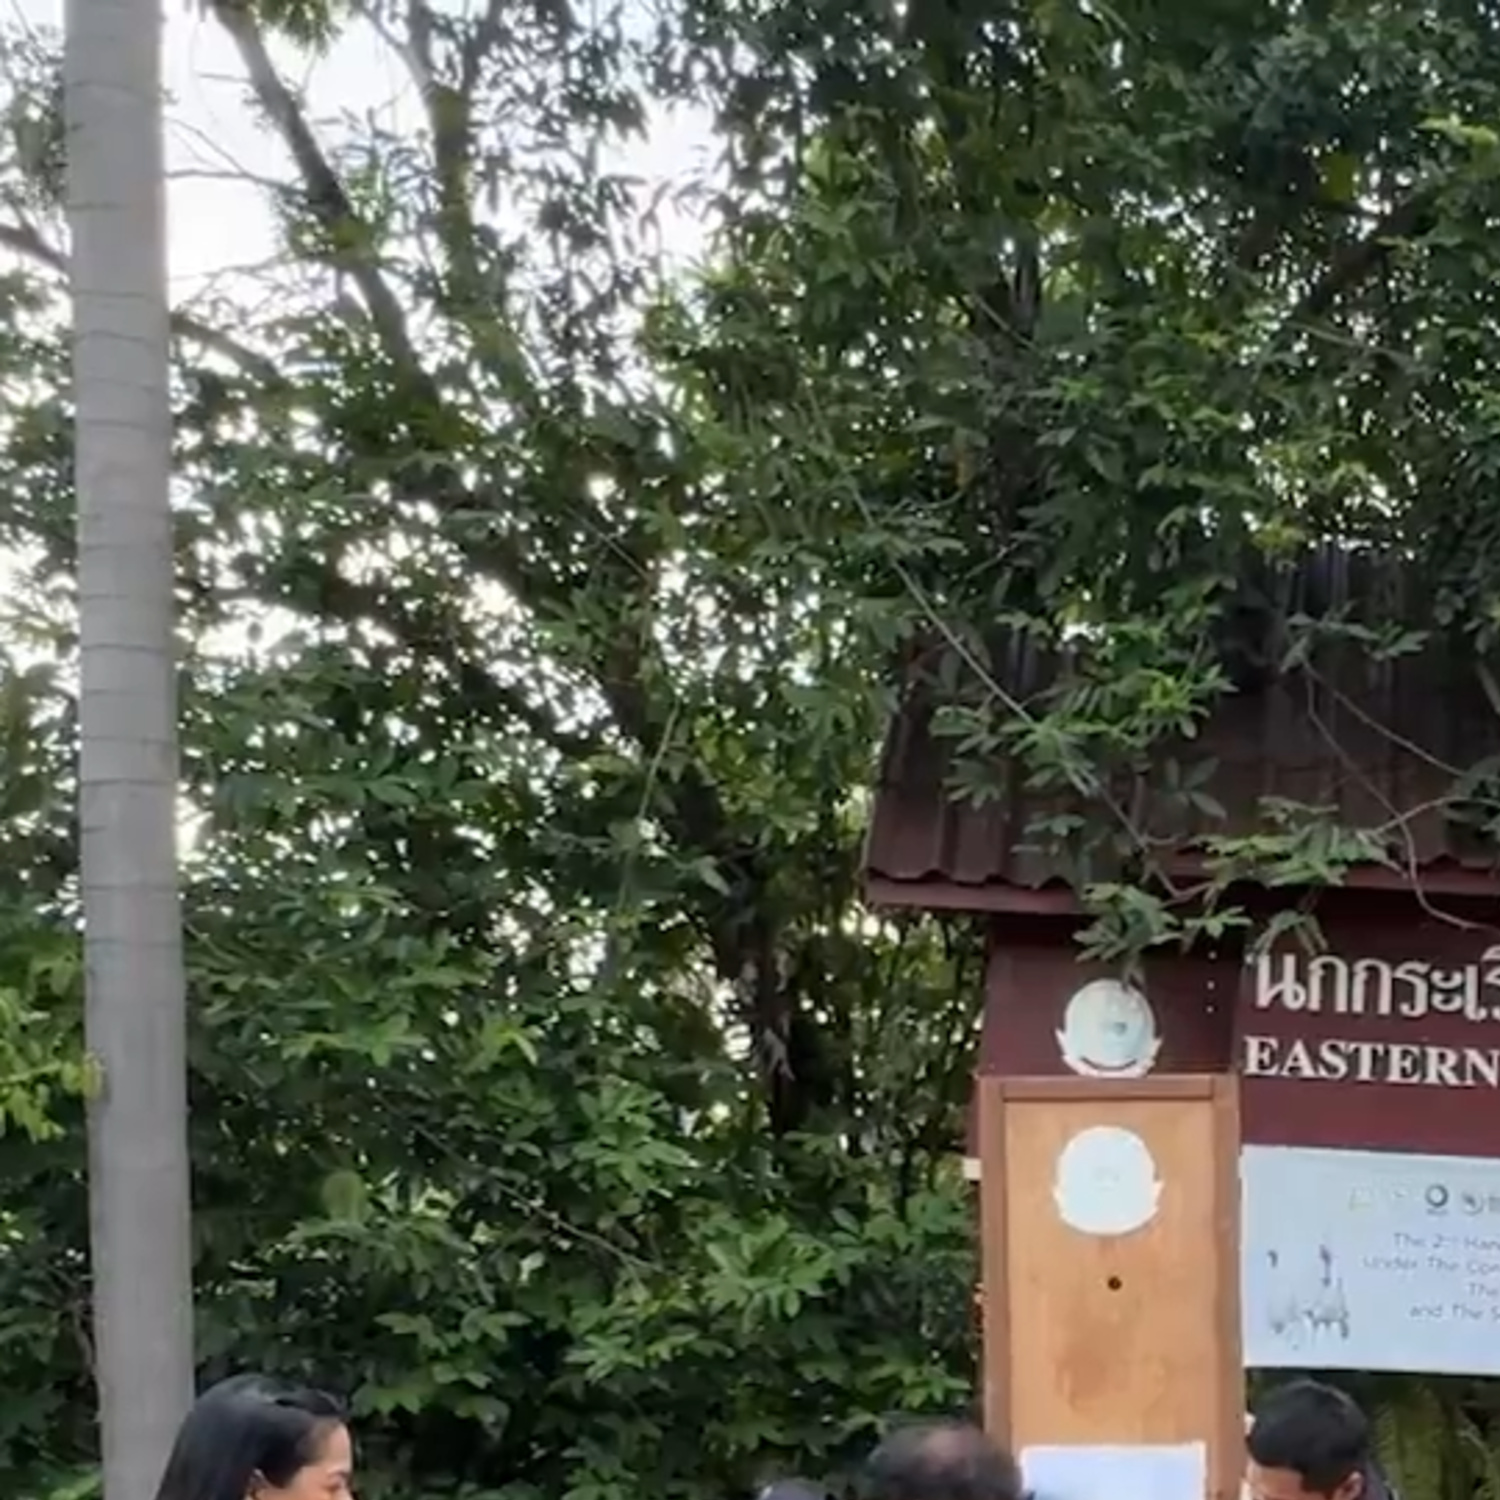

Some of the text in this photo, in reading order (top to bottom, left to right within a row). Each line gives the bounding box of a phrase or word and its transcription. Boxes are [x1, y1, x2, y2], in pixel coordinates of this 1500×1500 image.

[1392, 1231, 1426, 1248] The
[1468, 1282, 1500, 1298] The
[1408, 1303, 1443, 1320] and
